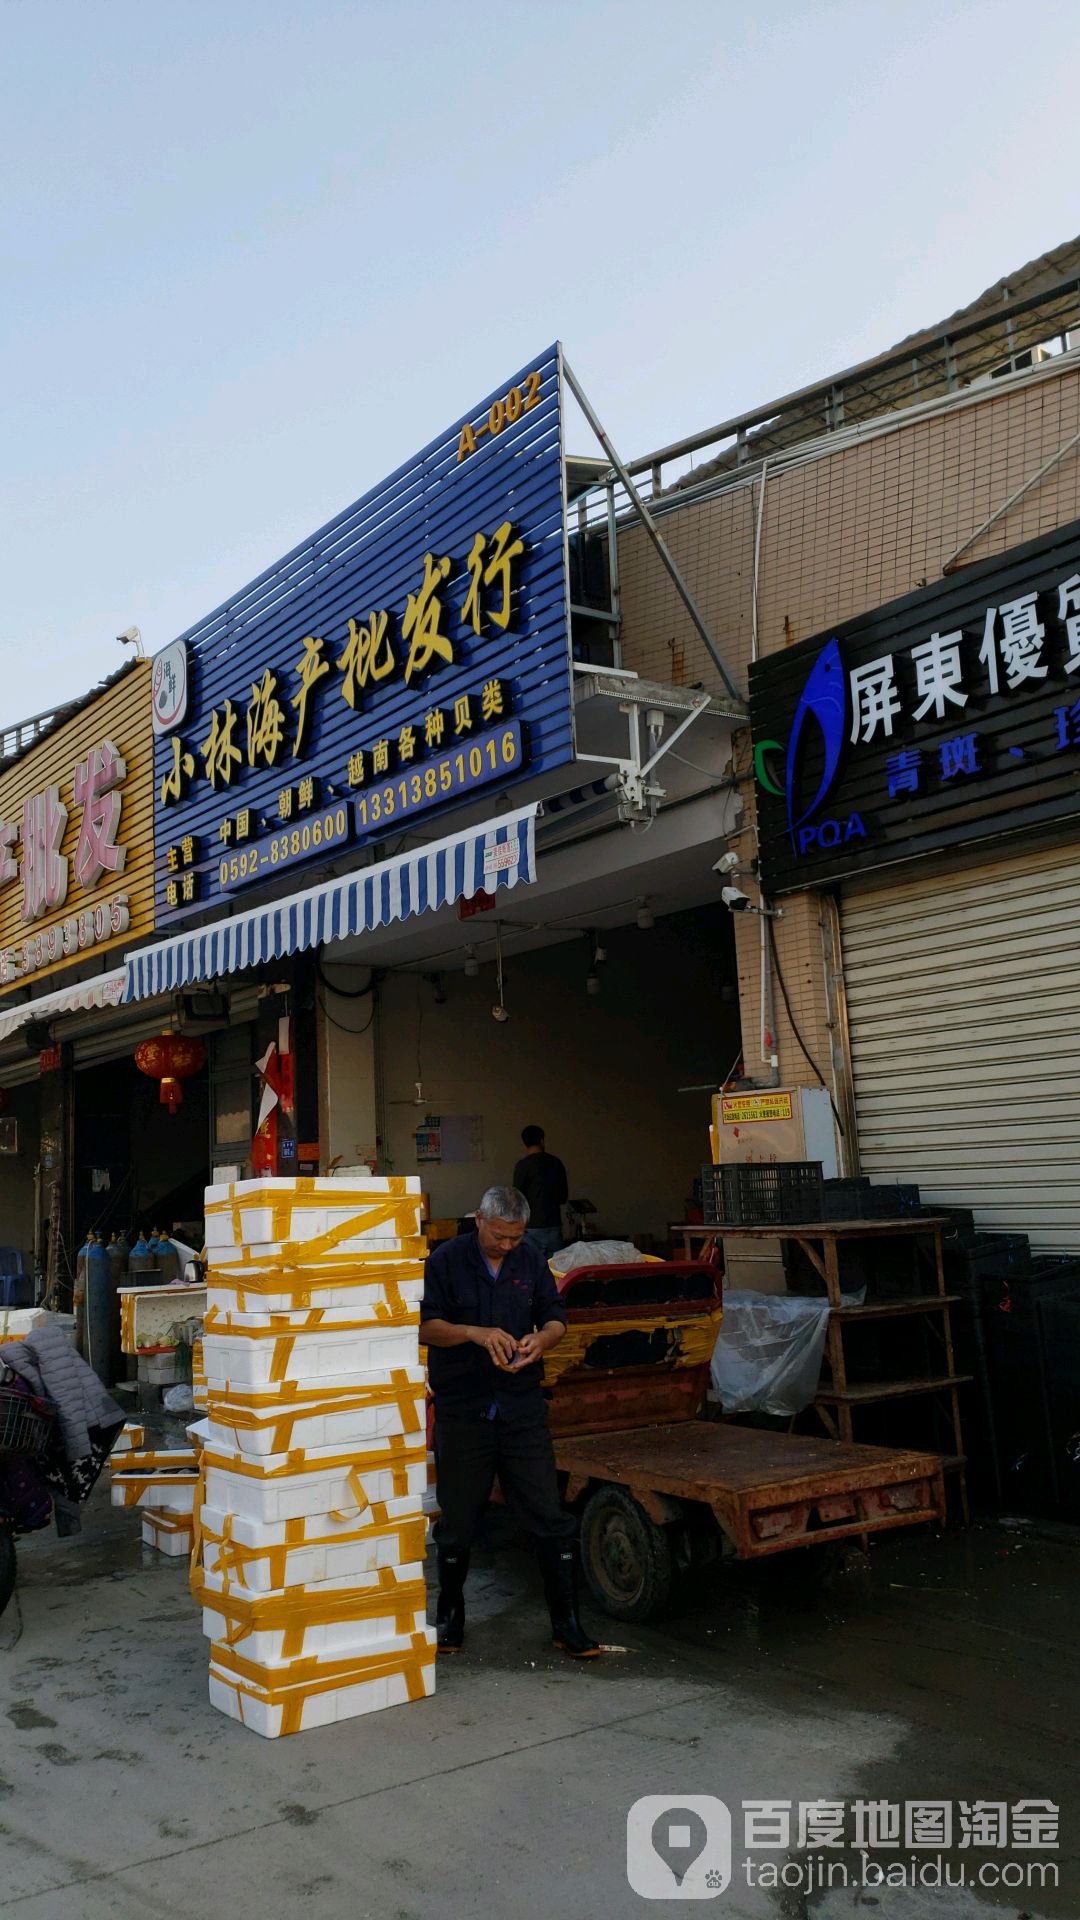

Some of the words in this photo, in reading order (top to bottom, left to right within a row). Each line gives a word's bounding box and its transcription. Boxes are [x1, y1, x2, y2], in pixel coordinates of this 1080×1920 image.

[456, 371, 543, 463] A-002
[161, 521, 524, 802] 小林海产批发行
[166, 836, 194, 877] 主营
[220, 680, 504, 844] 中国、朝鲜、越南各种贝类
[166, 872, 194, 907] 电话
[219, 809, 347, 887] 0592-8380600
[358, 730, 517, 825] 13313851016
[799, 811, 868, 855] PQA
